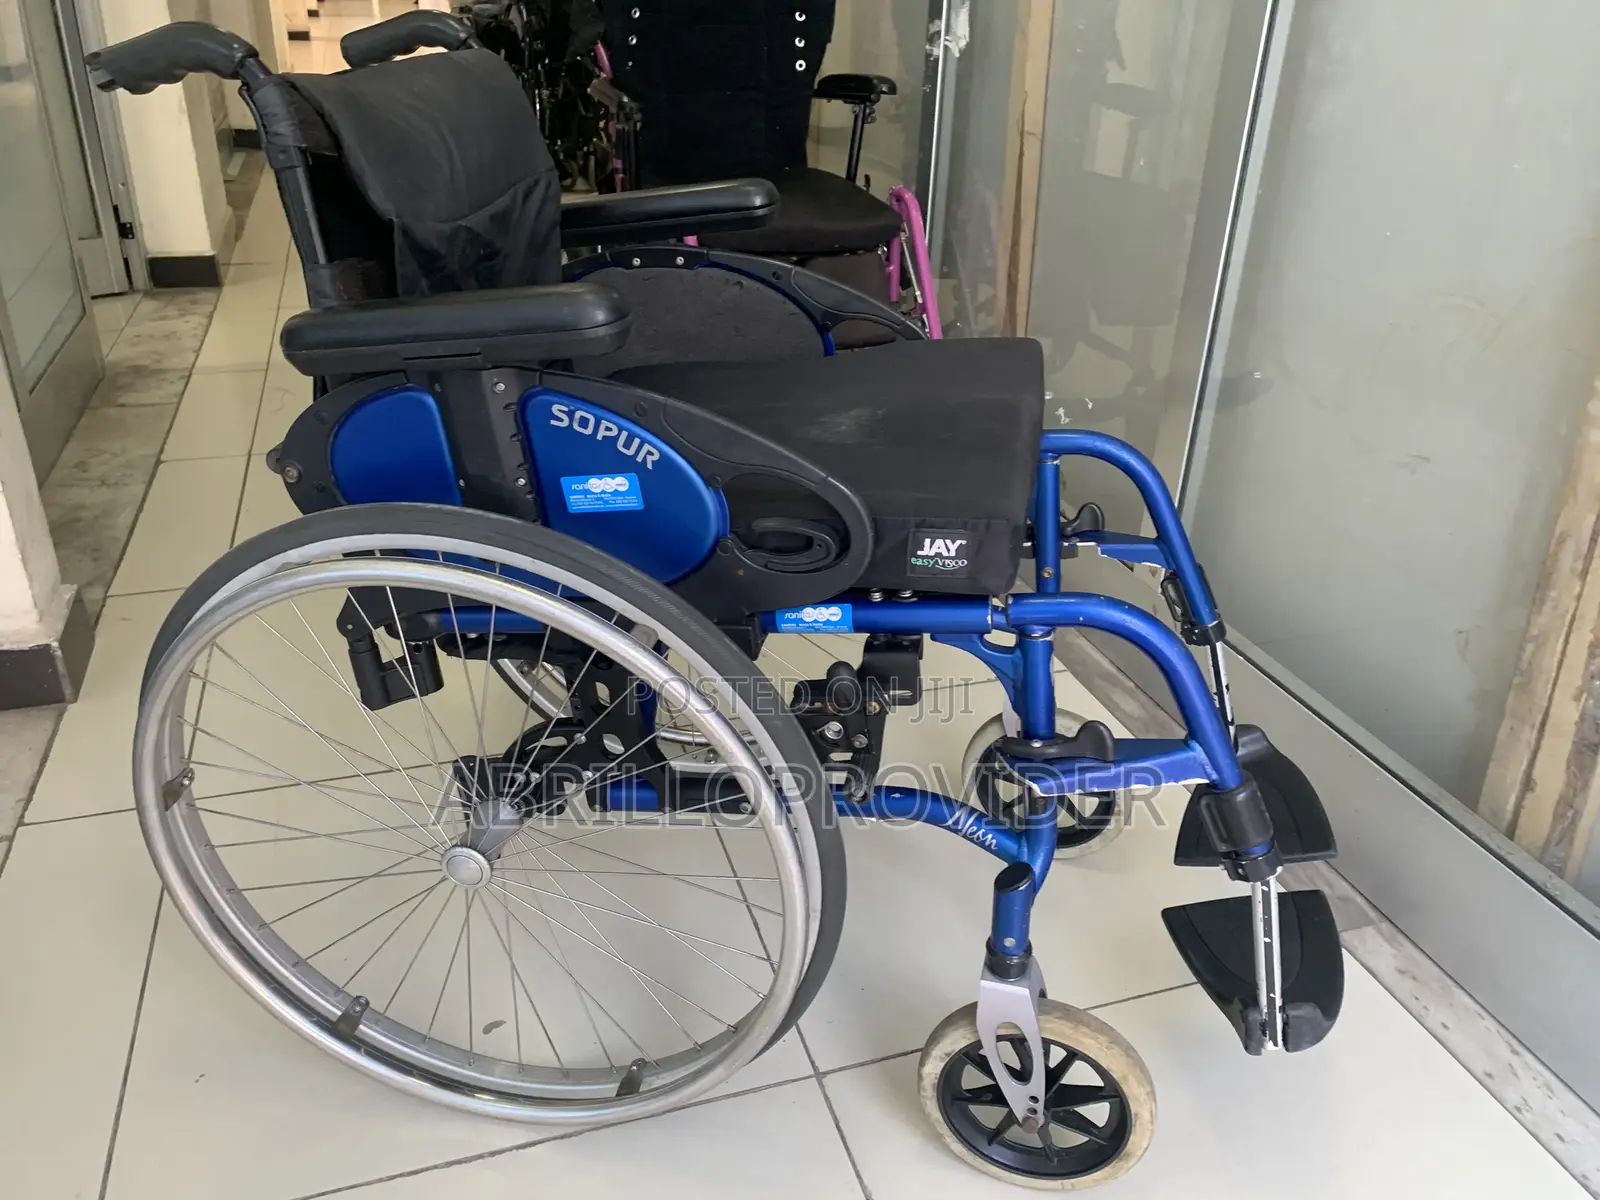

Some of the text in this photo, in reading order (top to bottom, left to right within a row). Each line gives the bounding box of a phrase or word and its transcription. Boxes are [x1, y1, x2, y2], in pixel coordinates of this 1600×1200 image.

[550, 404, 660, 470] SOPUR
[911, 557, 936, 567] easy
[916, 538, 963, 556] JAY
[939, 806, 998, 850] Neon
